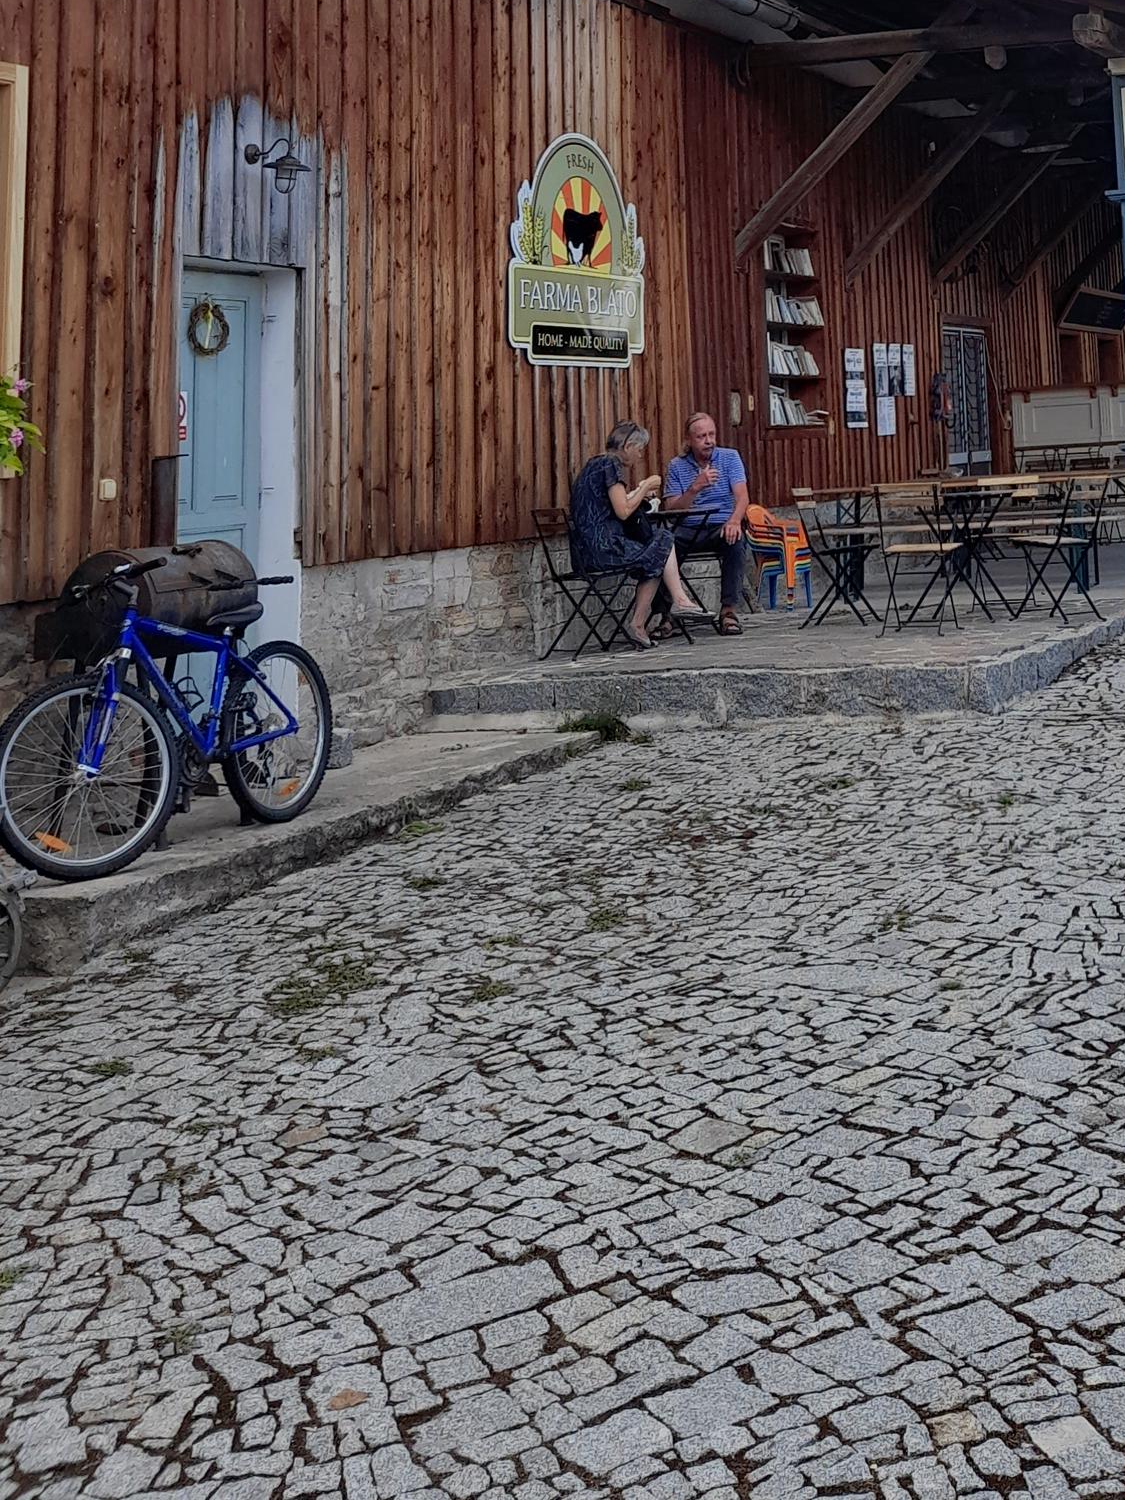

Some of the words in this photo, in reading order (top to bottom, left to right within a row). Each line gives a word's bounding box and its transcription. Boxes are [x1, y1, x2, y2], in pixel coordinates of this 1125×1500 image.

[566, 153, 594, 175] FRESH
[520, 279, 584, 313] FARMA
[587, 282, 637, 318] BLÁTO
[537, 333, 563, 348] HOME
[569, 335, 592, 350] MADE
[593, 336, 625, 352] QUALITY
